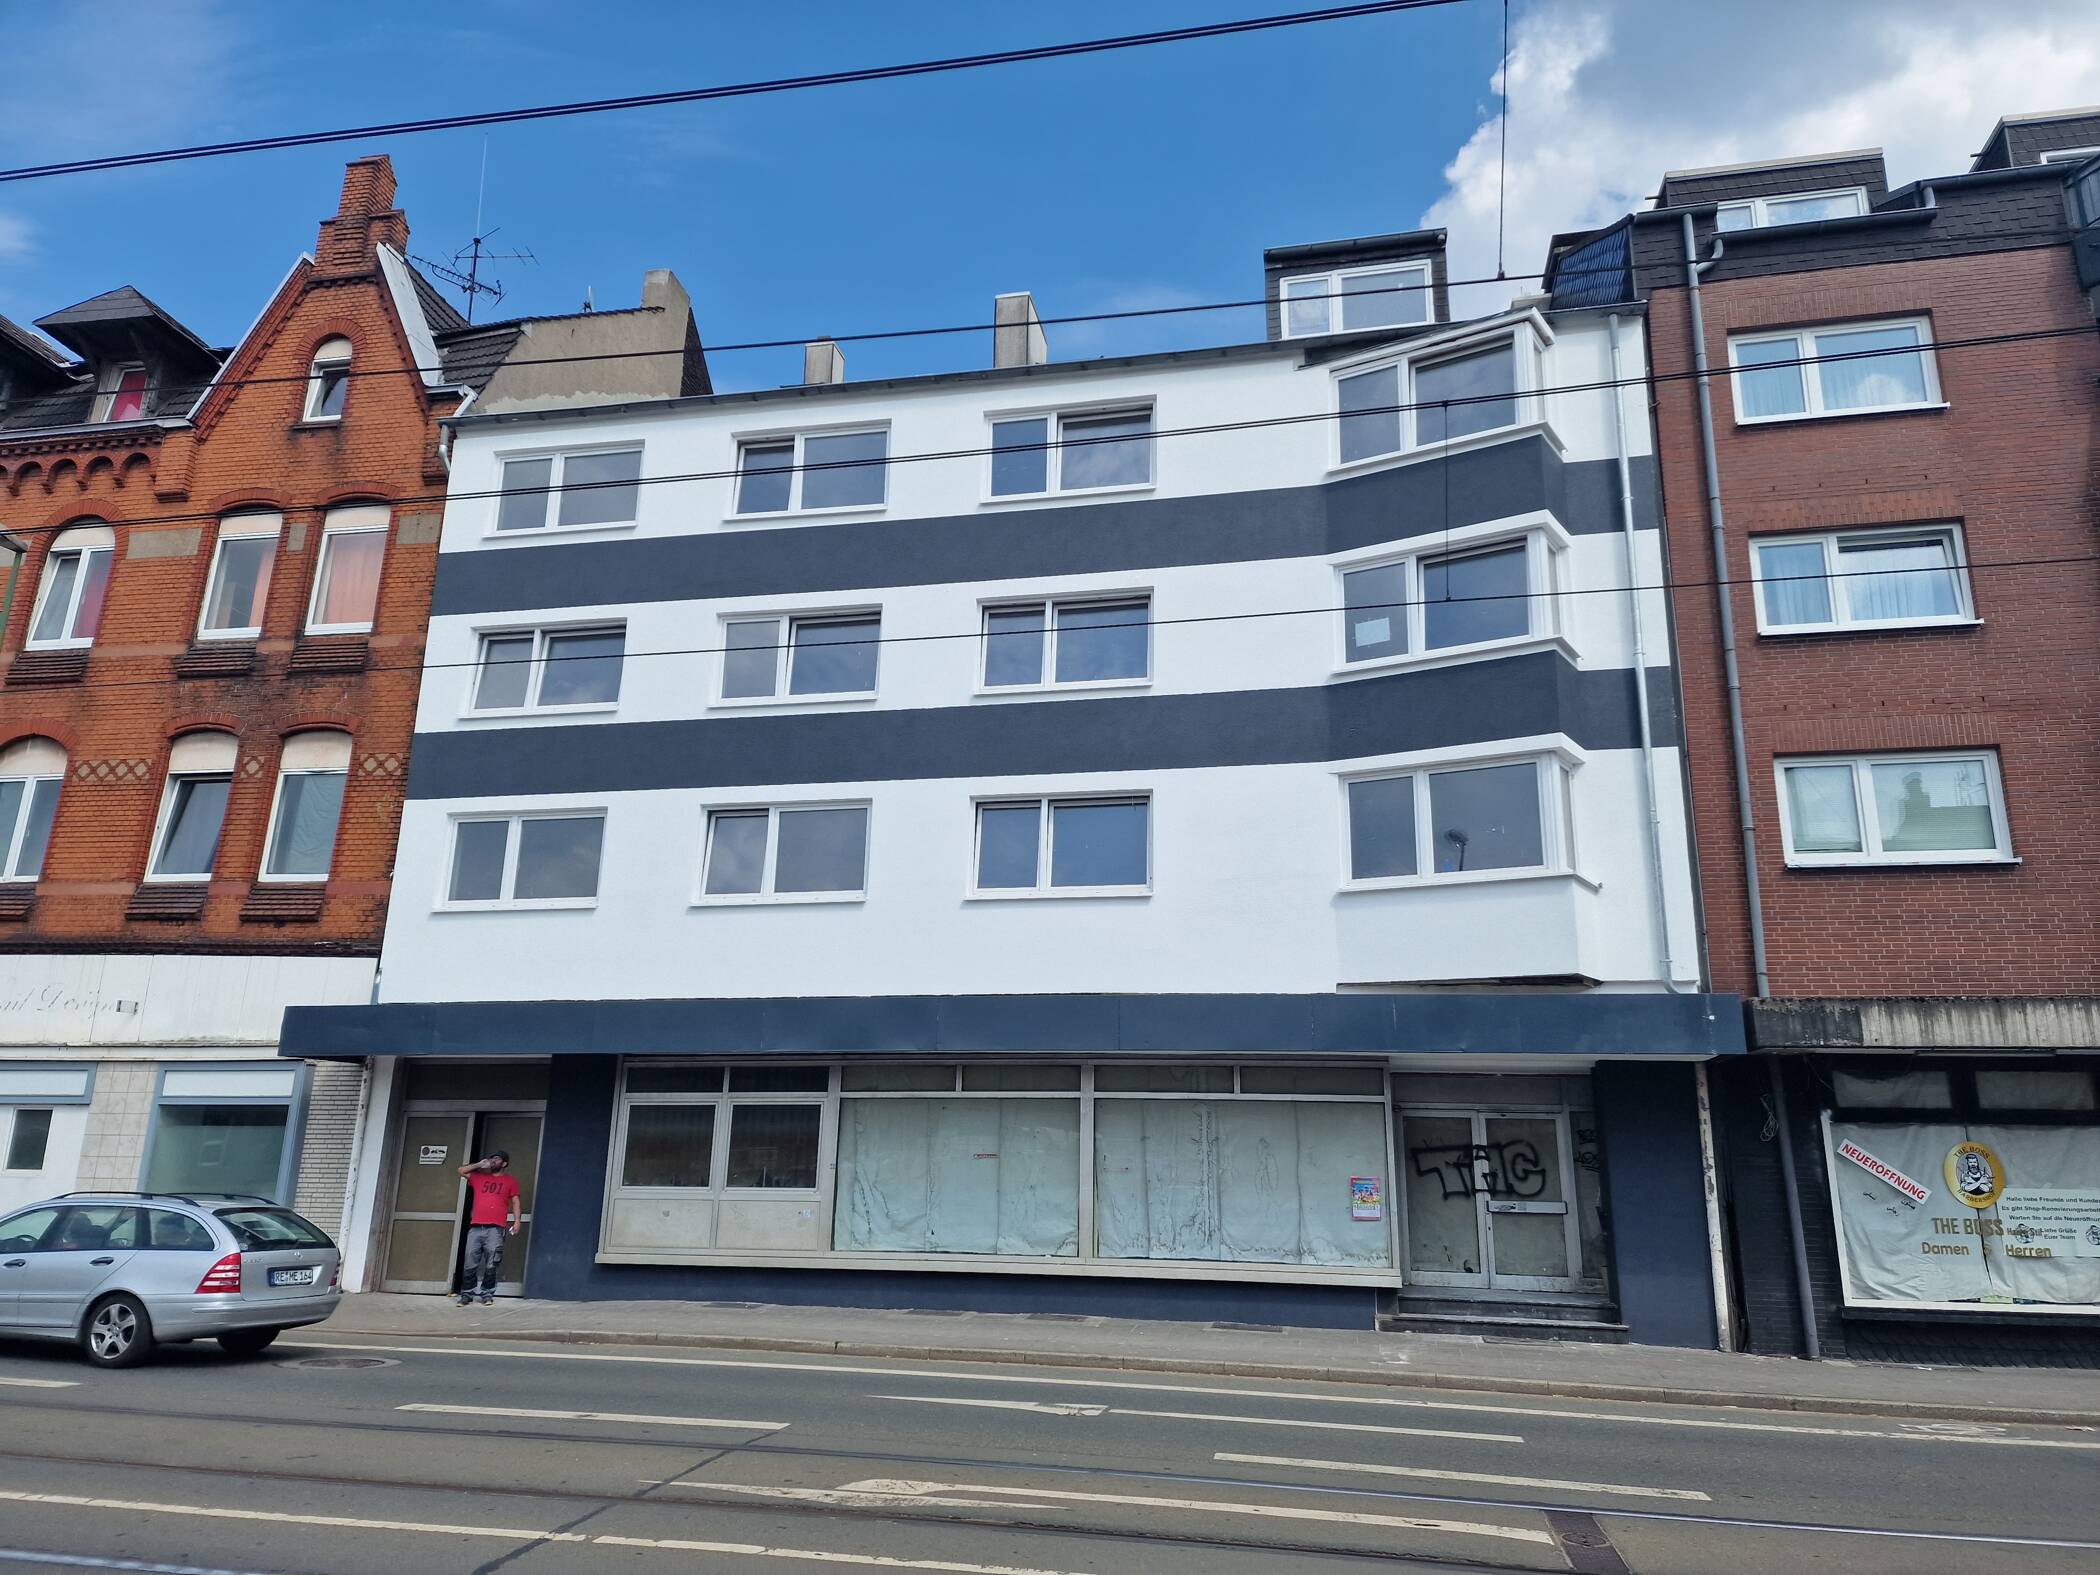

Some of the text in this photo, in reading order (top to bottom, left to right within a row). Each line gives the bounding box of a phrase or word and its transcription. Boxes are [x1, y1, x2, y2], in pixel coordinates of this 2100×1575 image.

[1952, 1146, 1991, 1159] THE BOSS
[482, 1181, 504, 1194] 501
[1931, 1217, 1960, 1235] THE
[1963, 1218, 2004, 1236] BOSS
[1921, 1241, 1970, 1256] Damen
[2005, 1244, 2052, 1258] Herren
[276, 1271, 285, 1281] RE
[289, 1272, 298, 1281] ME
